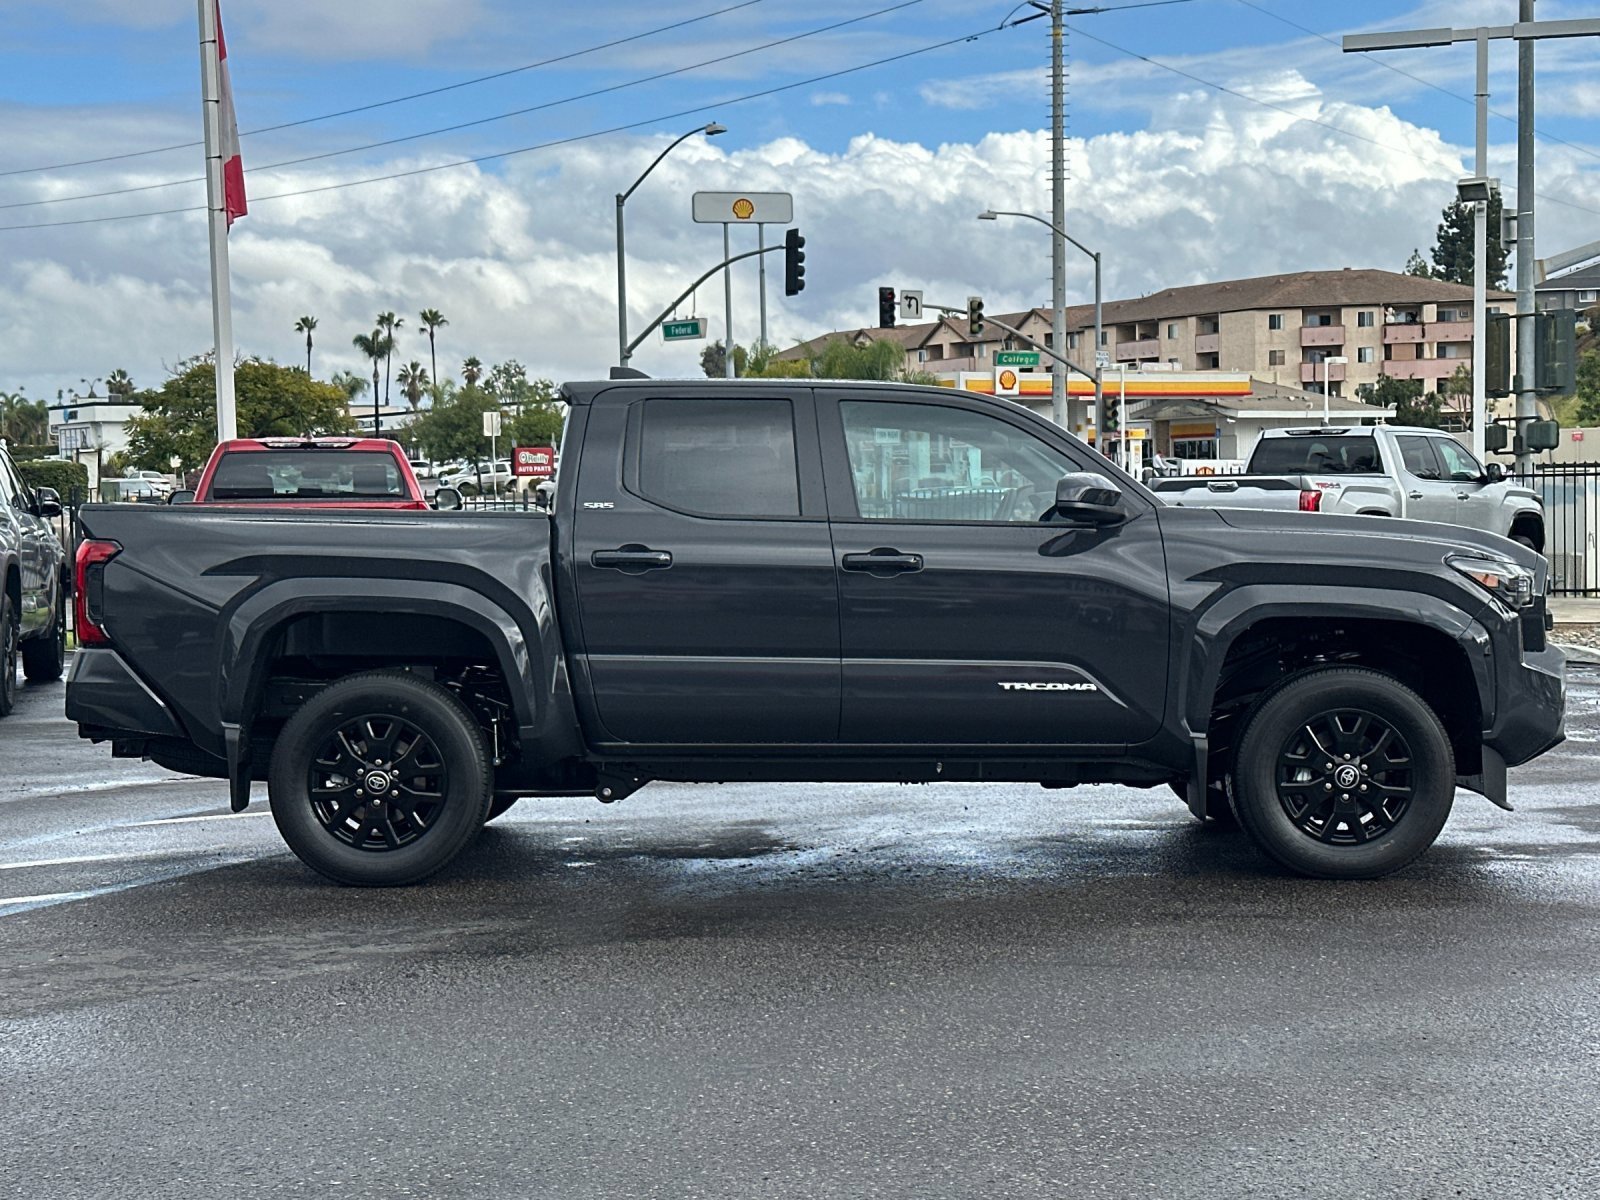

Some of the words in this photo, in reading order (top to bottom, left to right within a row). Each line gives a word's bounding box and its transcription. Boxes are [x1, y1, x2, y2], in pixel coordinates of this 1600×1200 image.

[671, 325, 693, 335] Federal
[1002, 355, 1034, 364] College
[998, 682, 1097, 691] TACOMA
